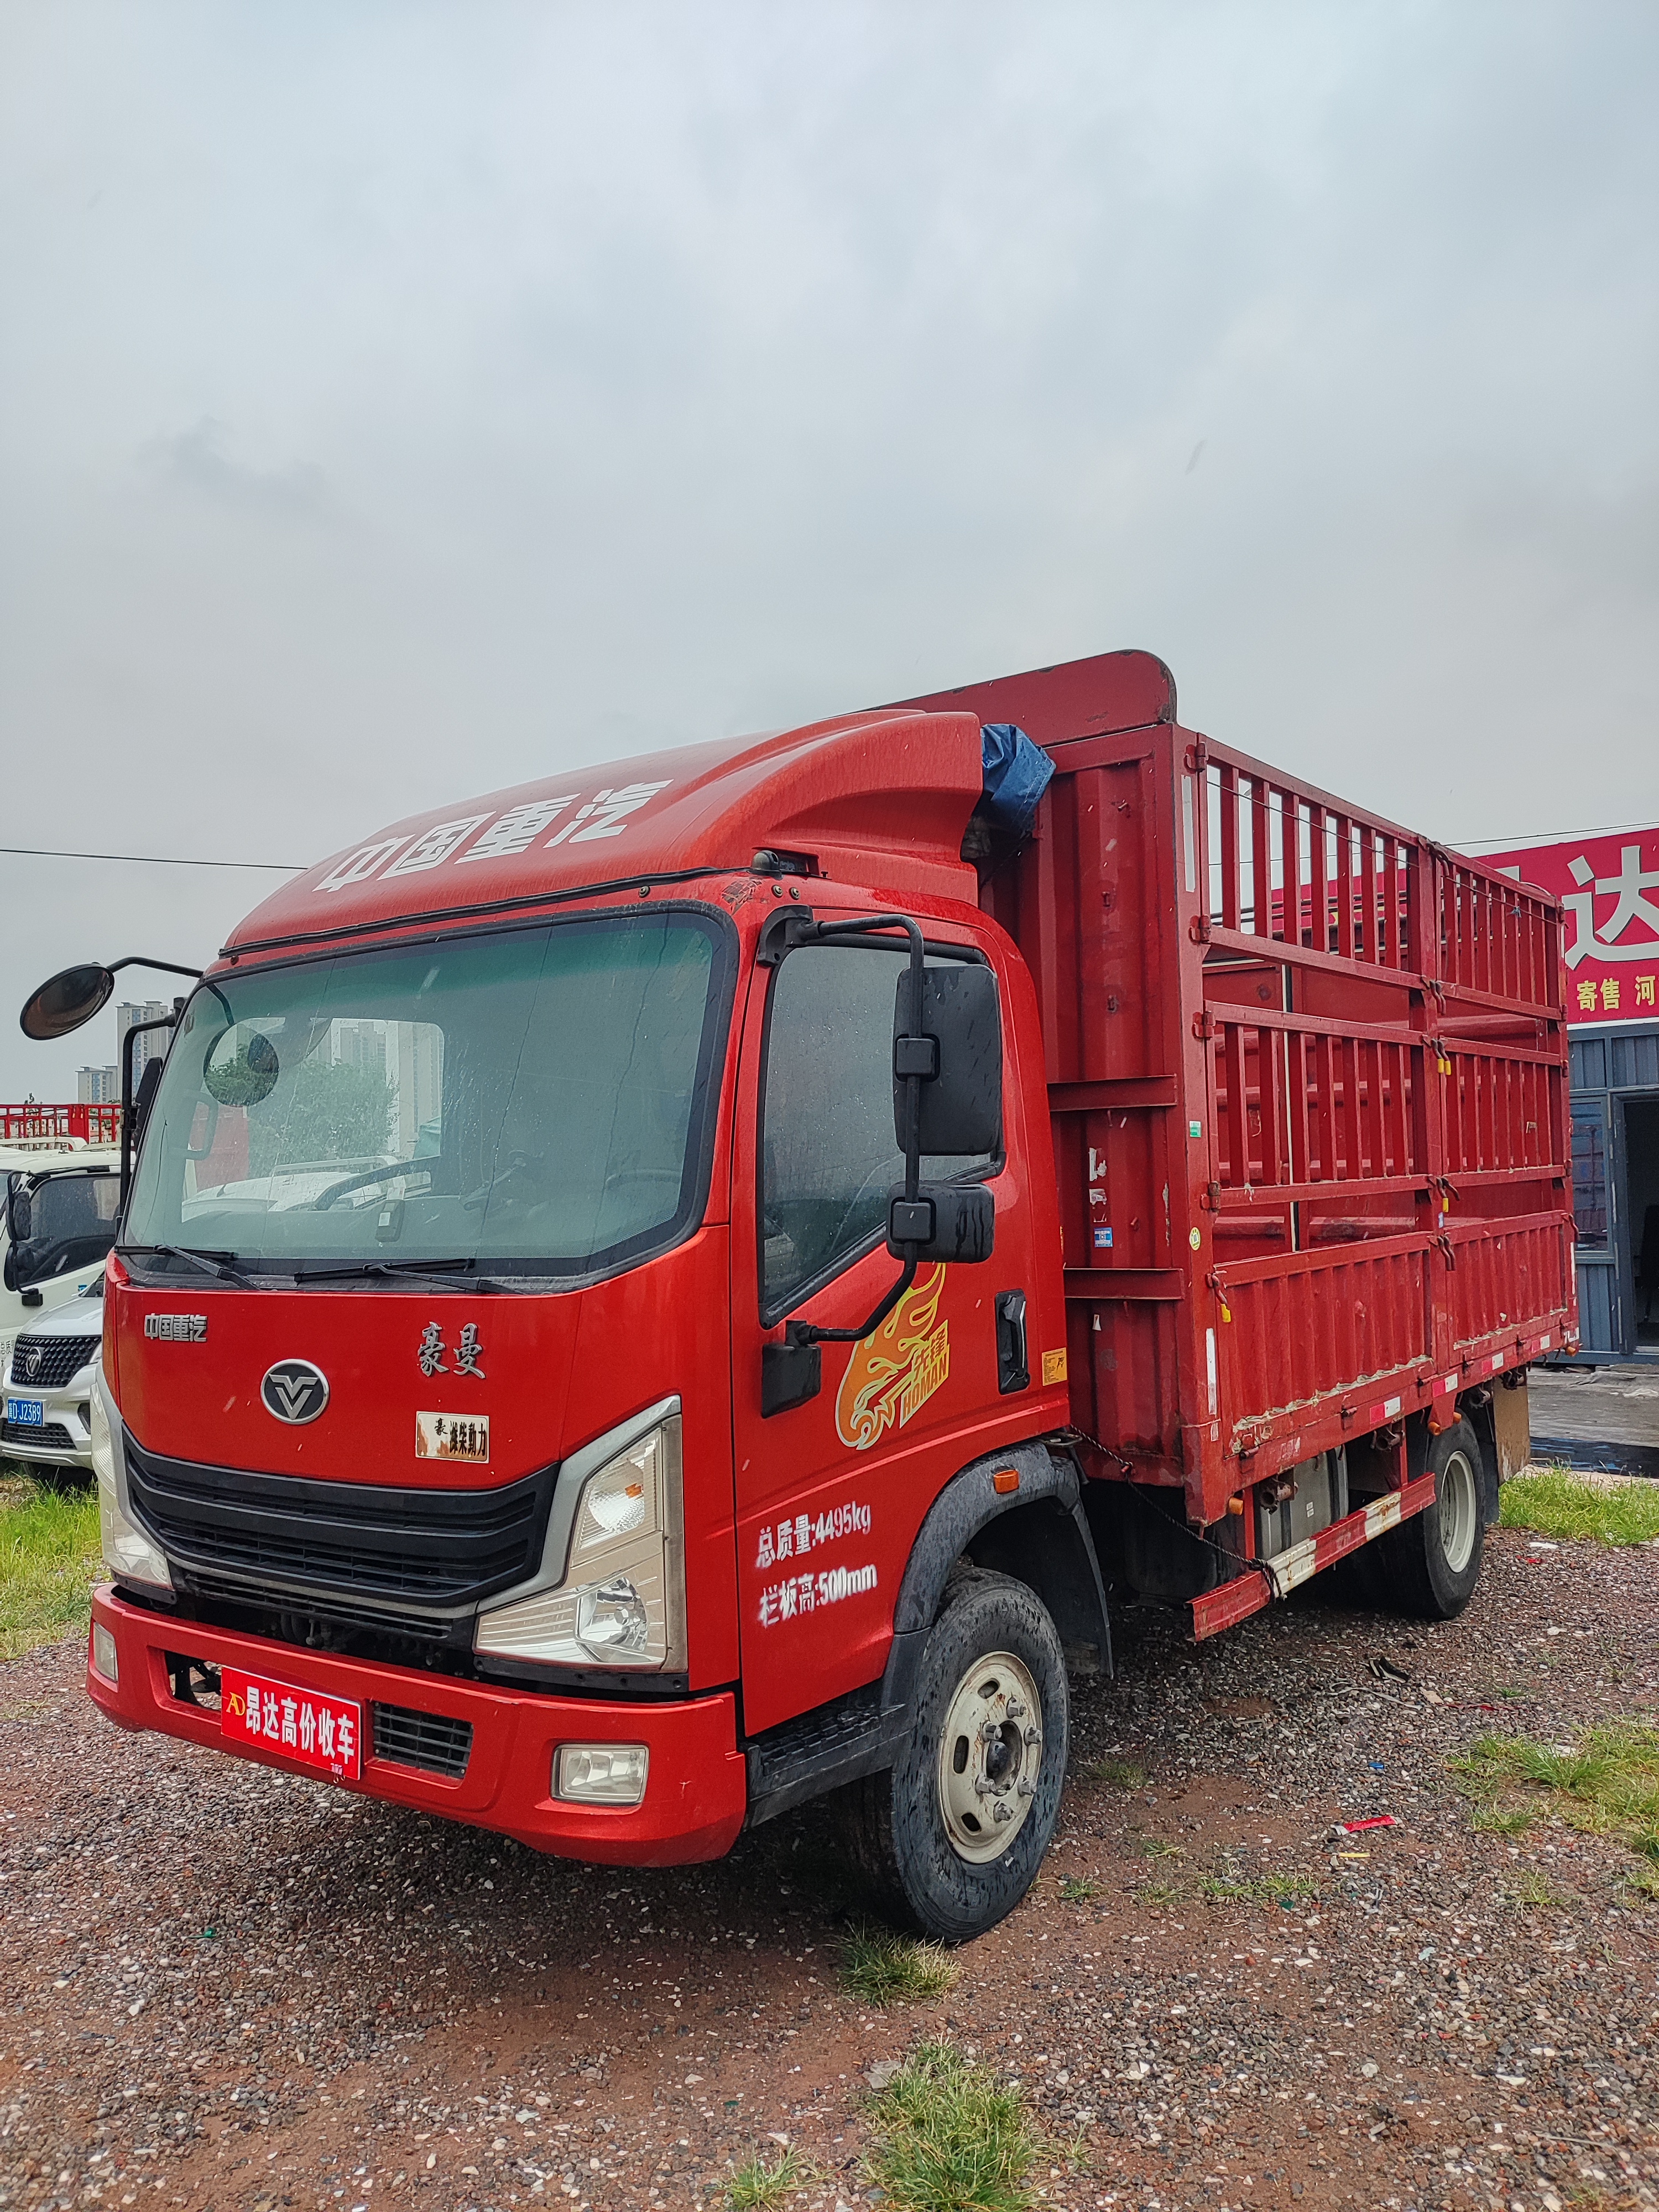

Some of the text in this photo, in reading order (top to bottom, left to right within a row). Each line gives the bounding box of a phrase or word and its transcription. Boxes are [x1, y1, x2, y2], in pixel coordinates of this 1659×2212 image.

[312, 779, 674, 893] 中国重汽
[1577, 975, 1659, 1012] 寄售 河
[144, 1313, 208, 1342] 中国重汽
[417, 1321, 487, 1379] 豪曼
[913, 1328, 946, 1382] 先锋
[902, 1352, 947, 1421] HOMAN
[434, 1417, 448, 1436] 豪
[755, 1501, 872, 1568] 总质量:4495kg
[758, 1563, 878, 1629] 栏板高:500mm
[246, 1686, 355, 1764] 昂达高价收车
